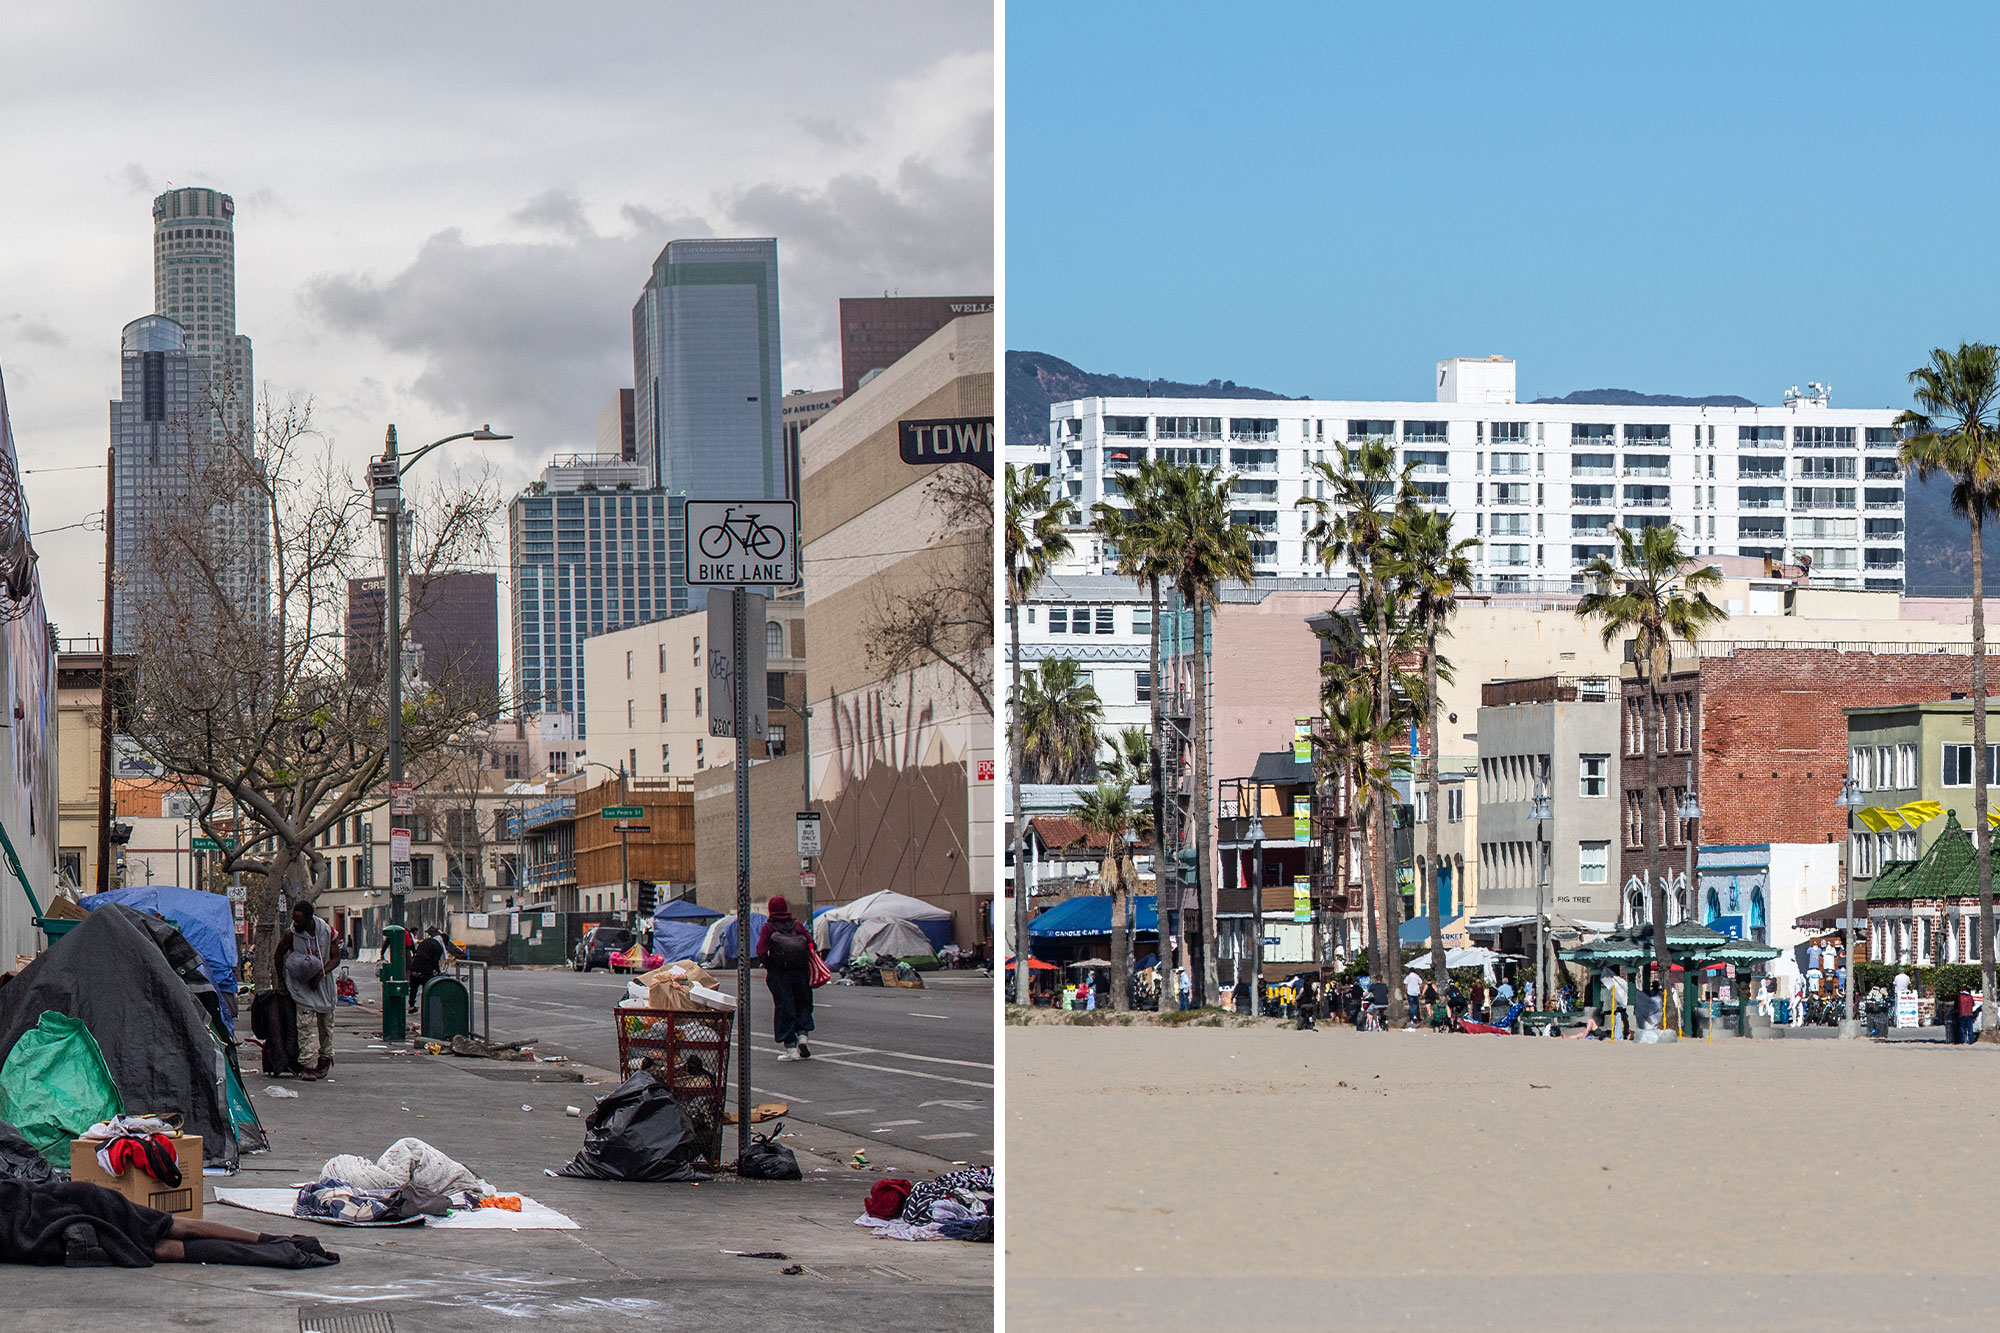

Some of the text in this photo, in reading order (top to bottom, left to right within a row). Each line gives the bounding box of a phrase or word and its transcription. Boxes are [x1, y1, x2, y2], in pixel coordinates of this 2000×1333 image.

[950, 303, 994, 313] WELLS
[782, 402, 830, 415] OF AMERICA
[699, 564, 783, 580] BIKE LANE
[361, 580, 386, 591] CBRE
[978, 761, 994, 772] FDC
